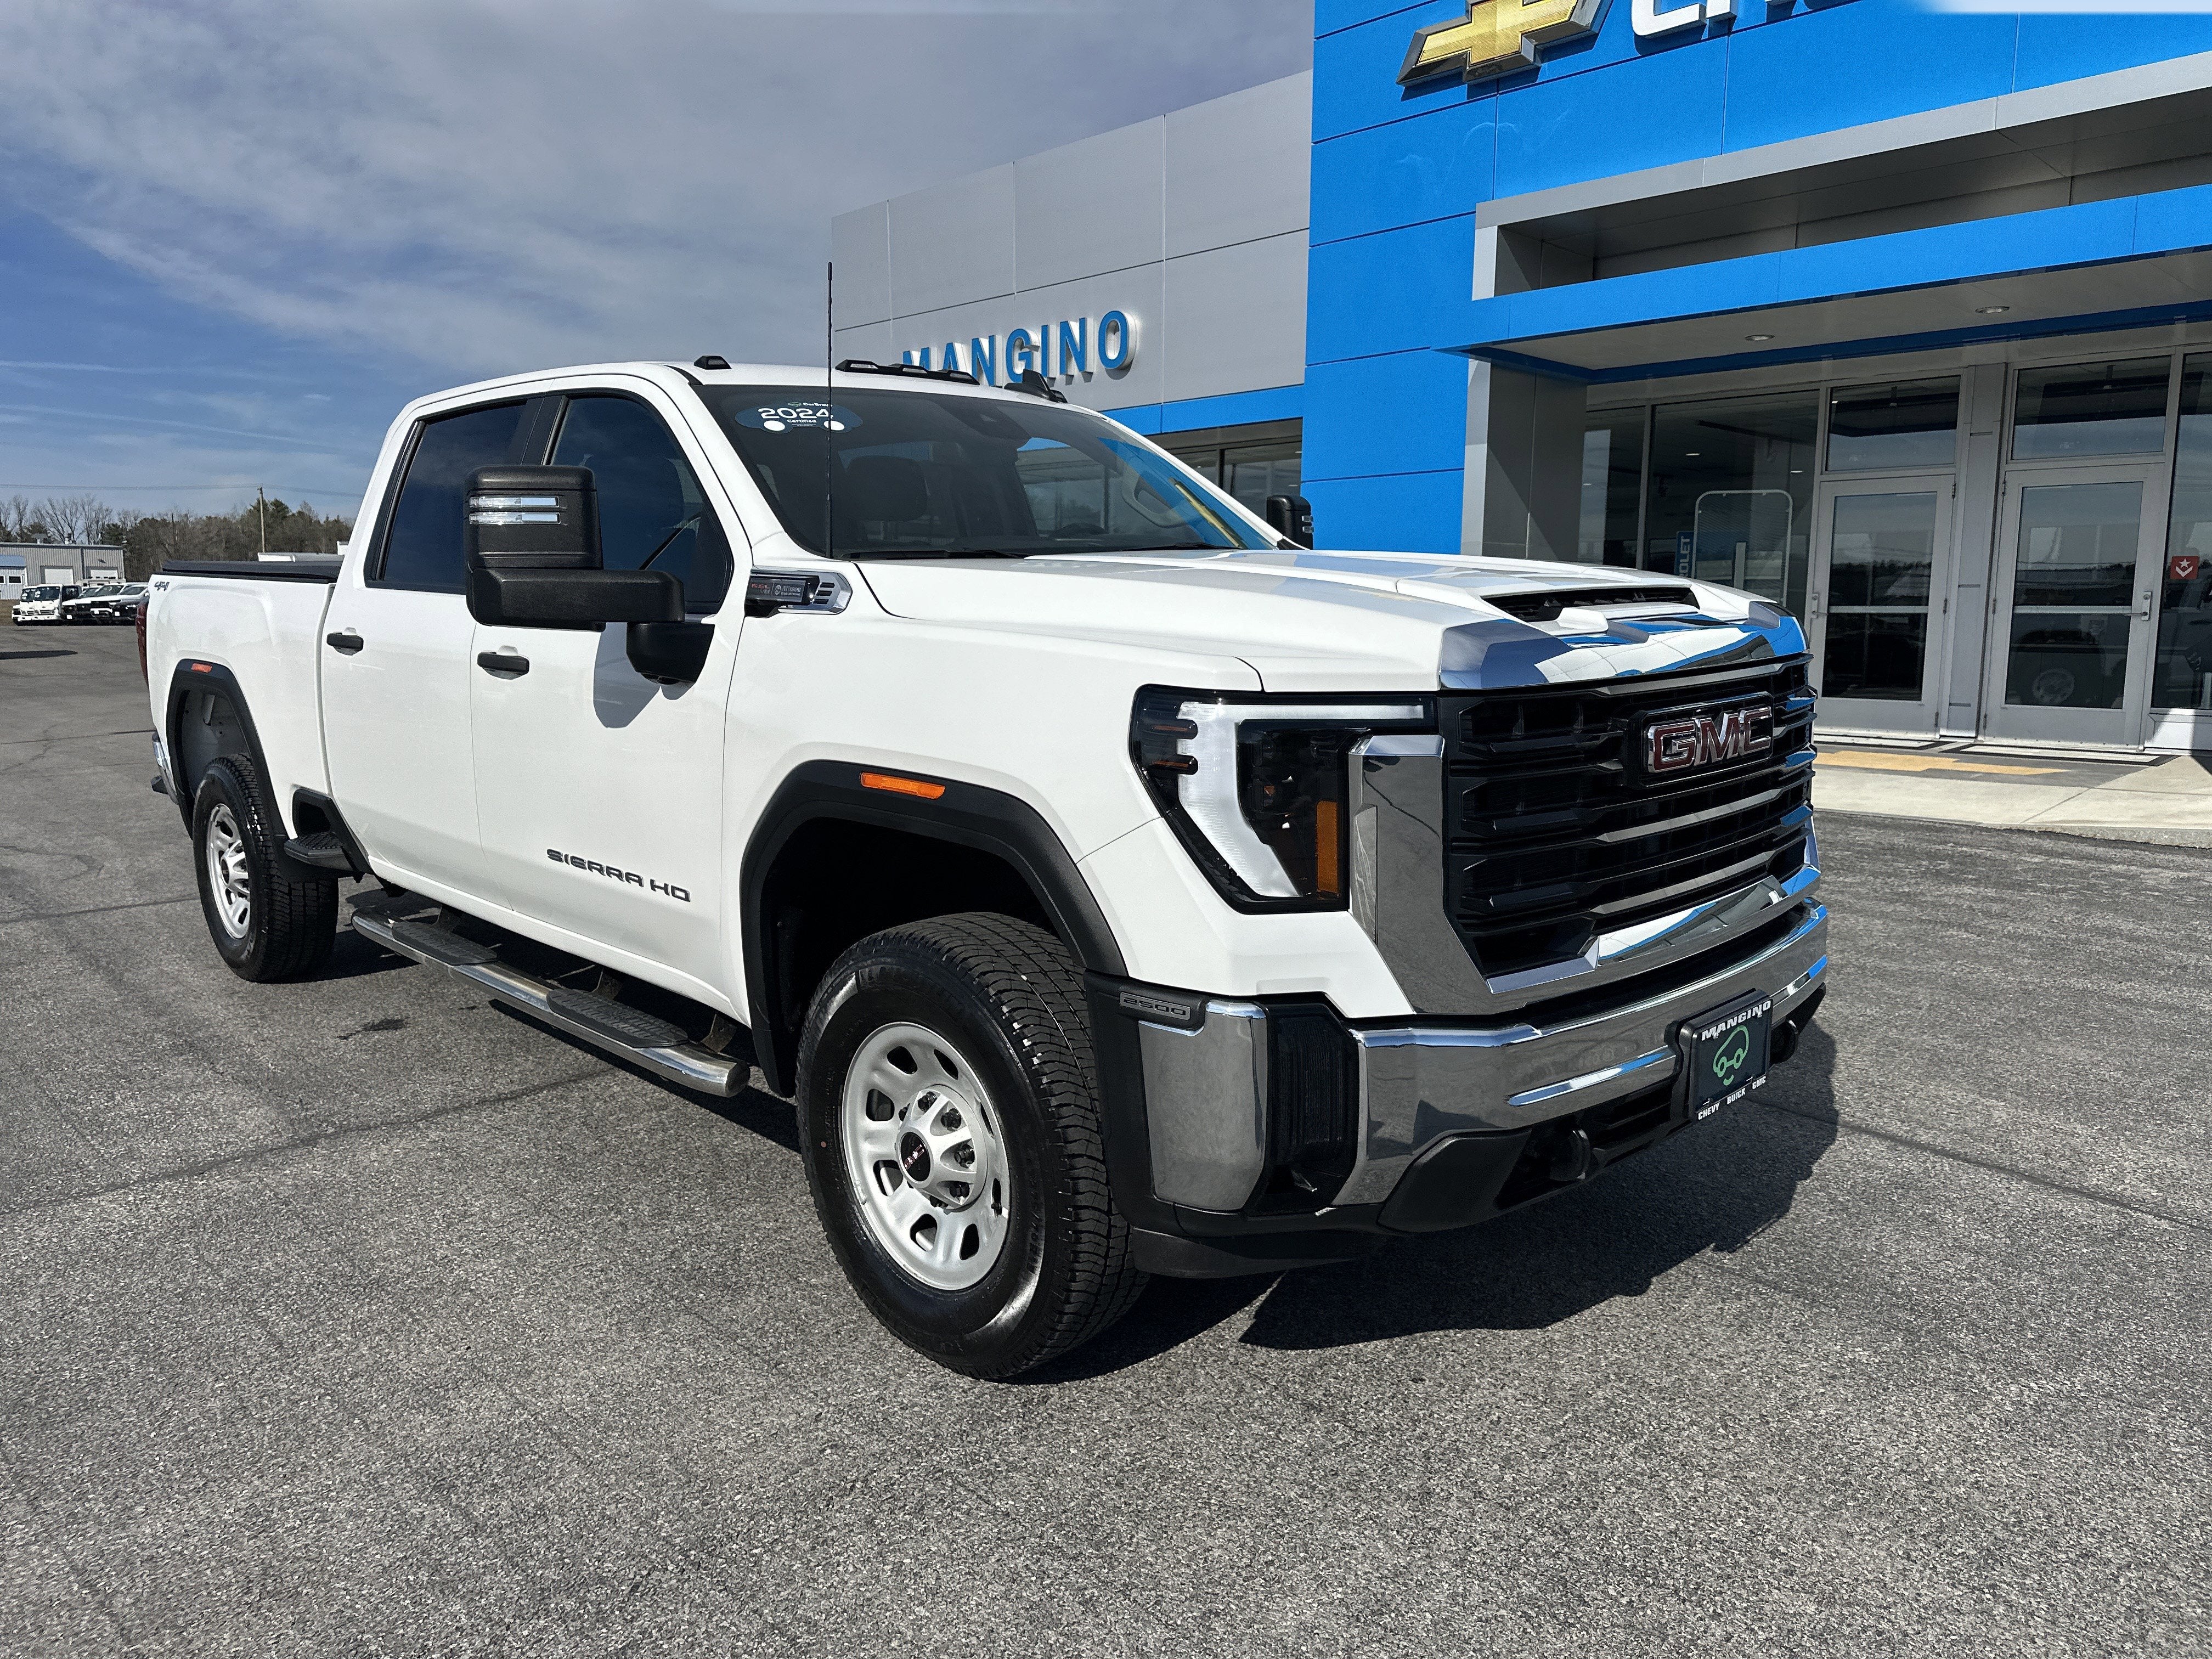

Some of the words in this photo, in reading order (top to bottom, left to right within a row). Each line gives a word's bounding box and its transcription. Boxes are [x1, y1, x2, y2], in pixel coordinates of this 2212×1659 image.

[758, 408, 834, 419] 2024
[1679, 535, 1690, 577] OLET
[1647, 706, 1772, 773] GMC
[546, 848, 644, 888] SIERRA
[650, 878, 691, 902] HD
[1124, 997, 1186, 1015] 2500
[1701, 1000, 1771, 1041] MANGINO
[1697, 1102, 1720, 1120] CHEVY
[1726, 1087, 1746, 1105] BUICK
[1752, 1076, 1767, 1090] GMC
